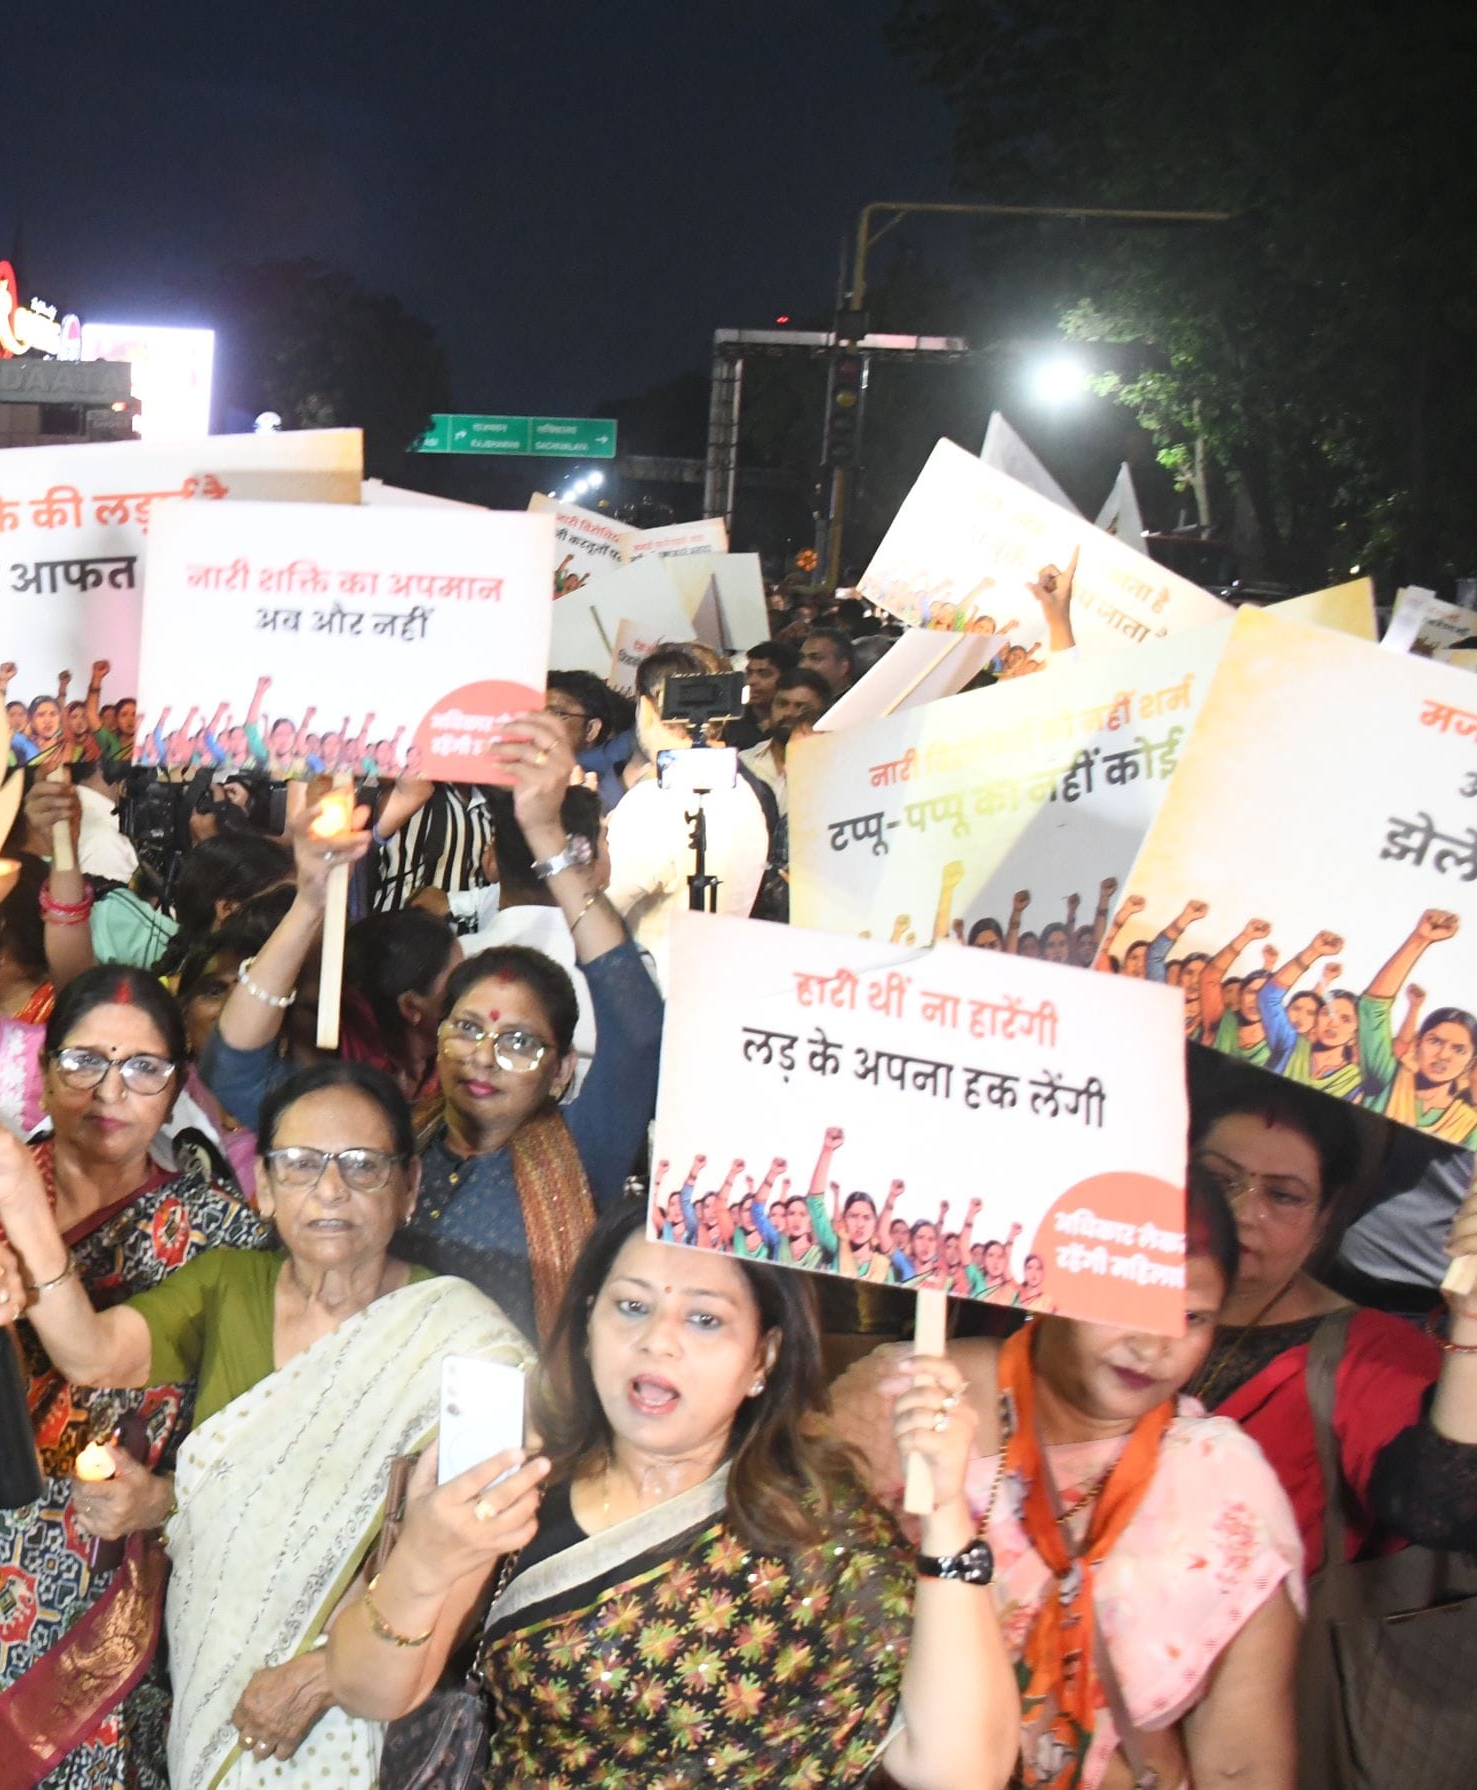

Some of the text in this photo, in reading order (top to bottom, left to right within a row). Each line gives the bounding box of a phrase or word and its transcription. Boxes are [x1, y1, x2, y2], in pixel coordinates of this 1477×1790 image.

[28, 485, 83, 529] की
[10, 555, 137, 596] आफत
[186, 557, 505, 603] नारी शक्ति का अपमान
[256, 600, 435, 642] अब और नहीं
[869, 746, 920, 789] नारी
[1138, 671, 1196, 720] शर्म
[1028, 746, 1101, 803] नहीं
[1103, 724, 1185, 786] कोई
[793, 967, 1061, 1049] हारी थीं ना हारेंगी
[741, 1024, 1107, 1130] लड़ के अपना हक लेंगी
